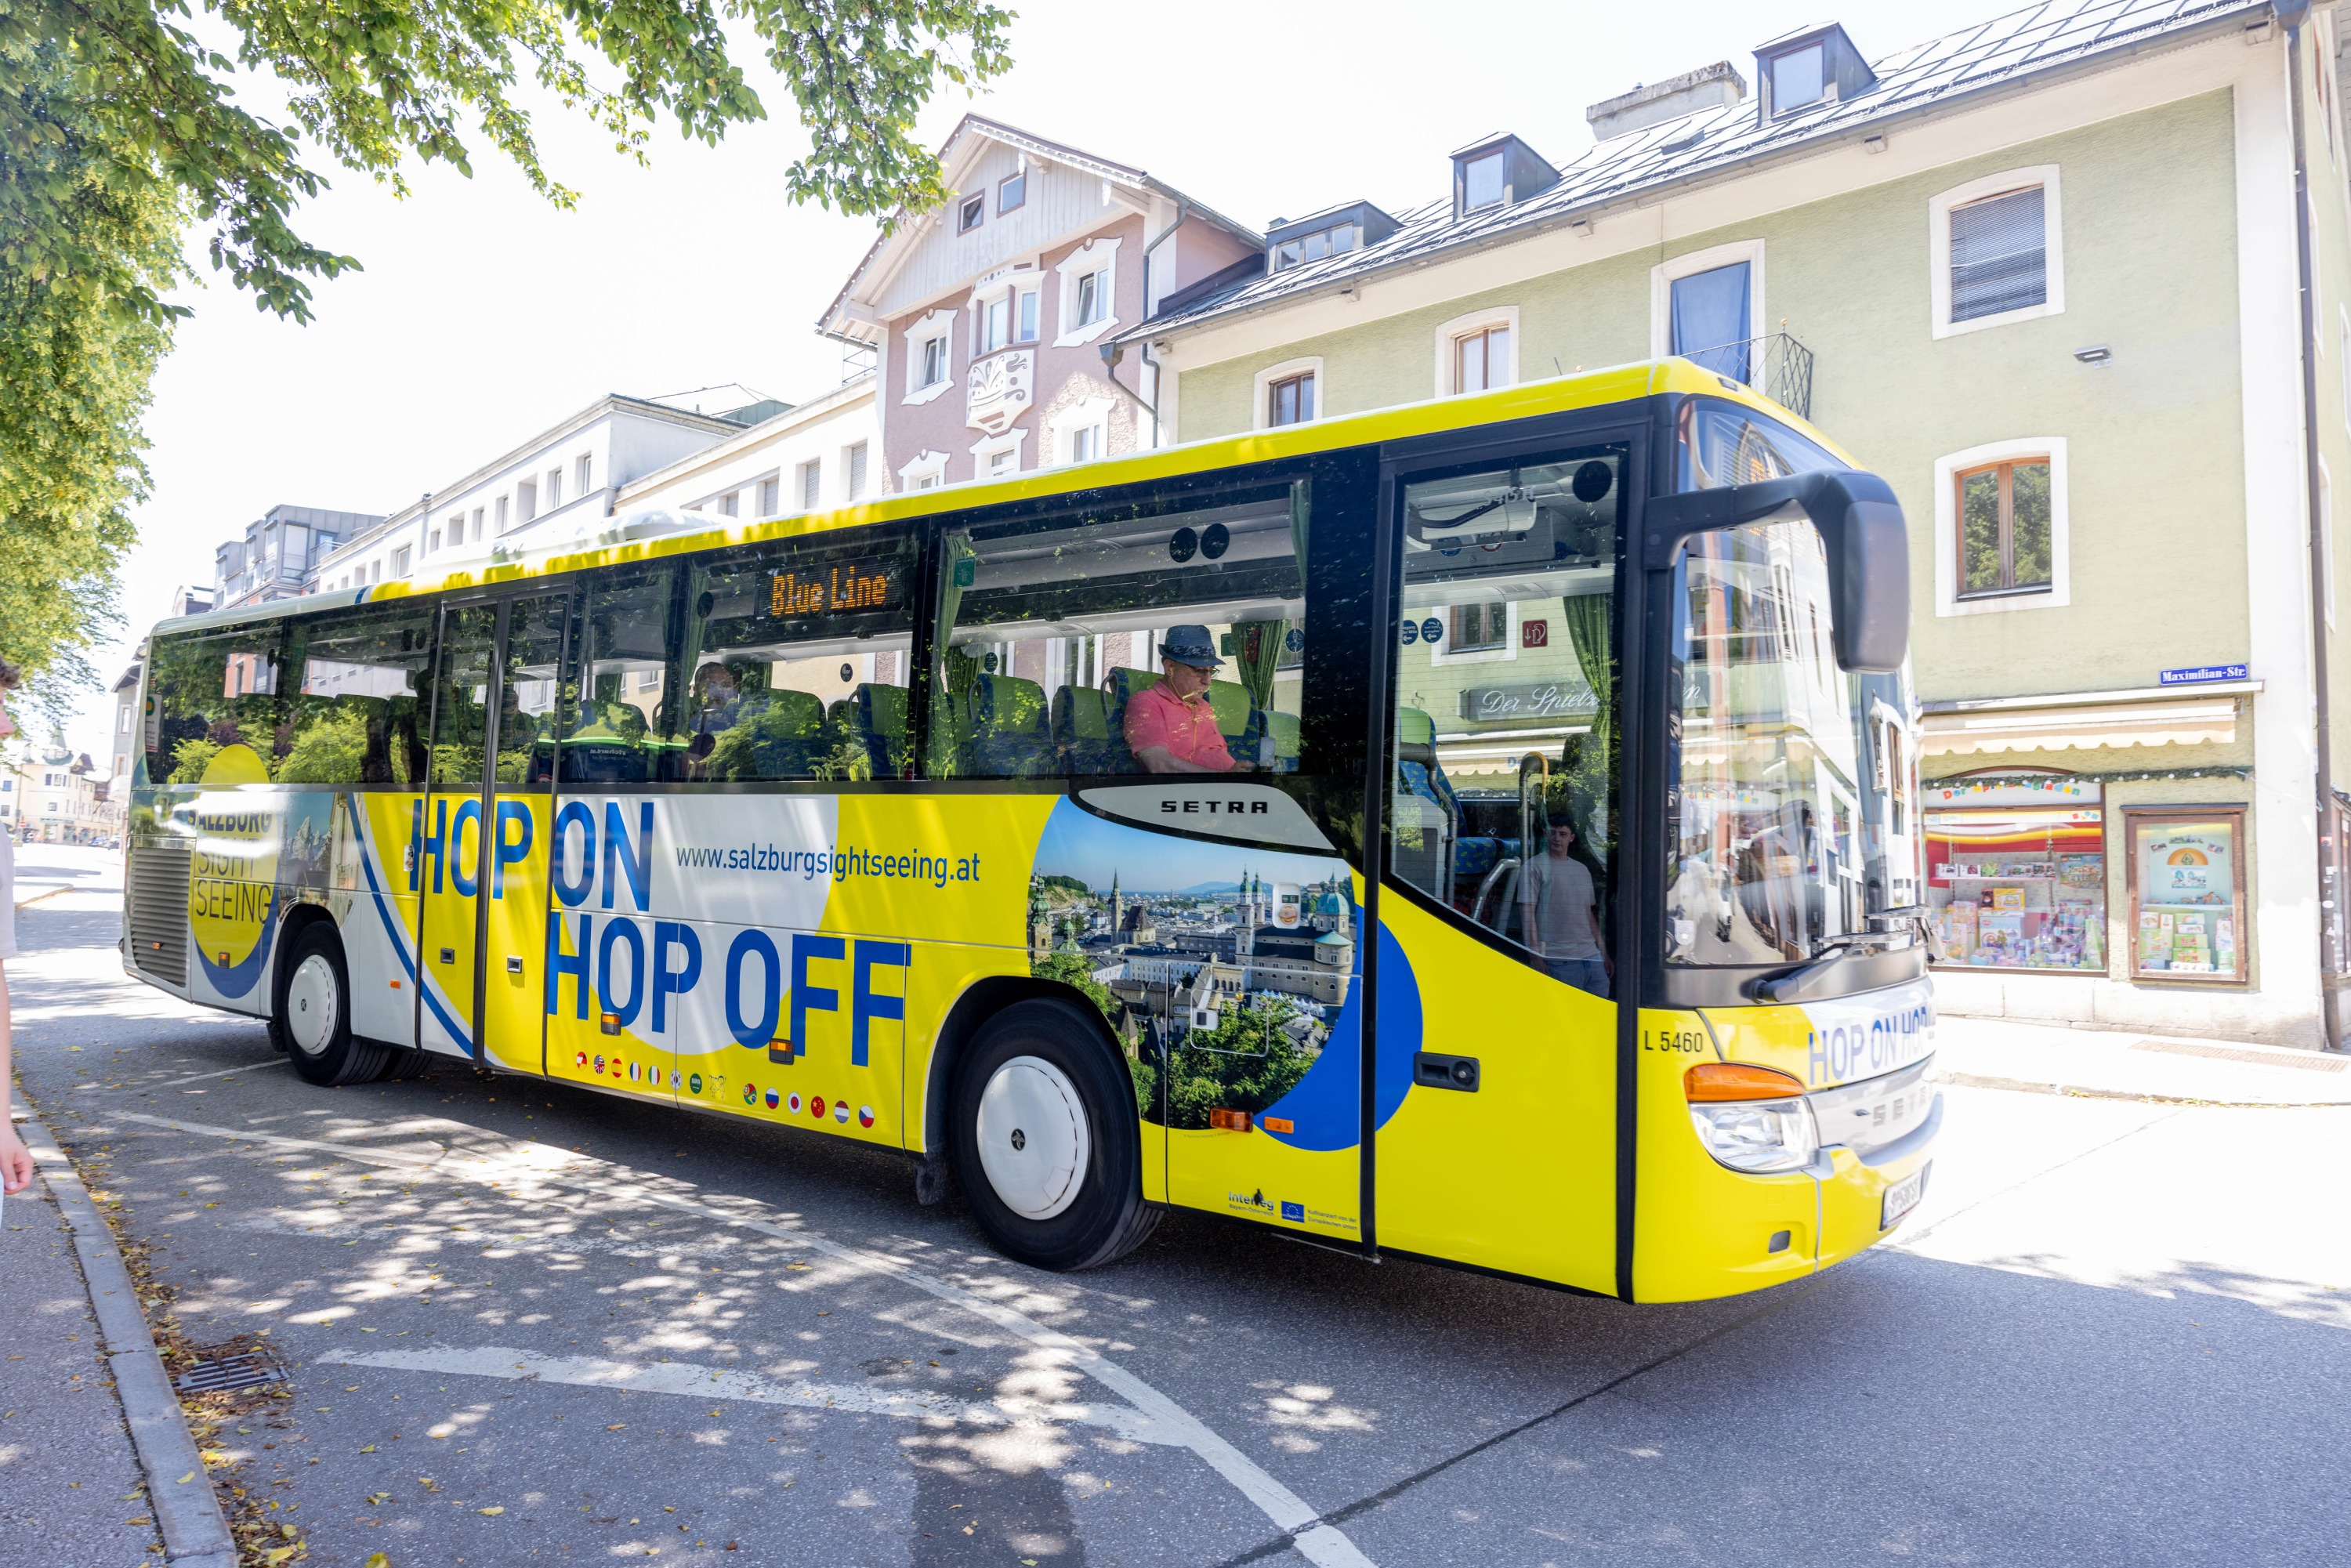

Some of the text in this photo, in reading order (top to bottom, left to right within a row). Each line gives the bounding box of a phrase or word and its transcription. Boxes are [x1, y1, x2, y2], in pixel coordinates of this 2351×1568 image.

[772, 566, 886, 615] Blue Line
[2162, 666, 2246, 682] Maximilian-Str.
[1481, 690, 1520, 713] Der
[1161, 801, 1268, 814] SETRA
[1943, 788, 1966, 799] Der
[409, 799, 654, 911] HOP ON
[676, 843, 980, 888] www.salzburgsightseeing.at
[196, 878, 271, 924] SEEING
[547, 911, 911, 1066] HOP OFF
[1645, 1030, 1703, 1052] L 5460
[1808, 1024, 1864, 1085] HOP
[1871, 1015, 1897, 1070] ON
[1228, 1190, 1274, 1211] Intereg
